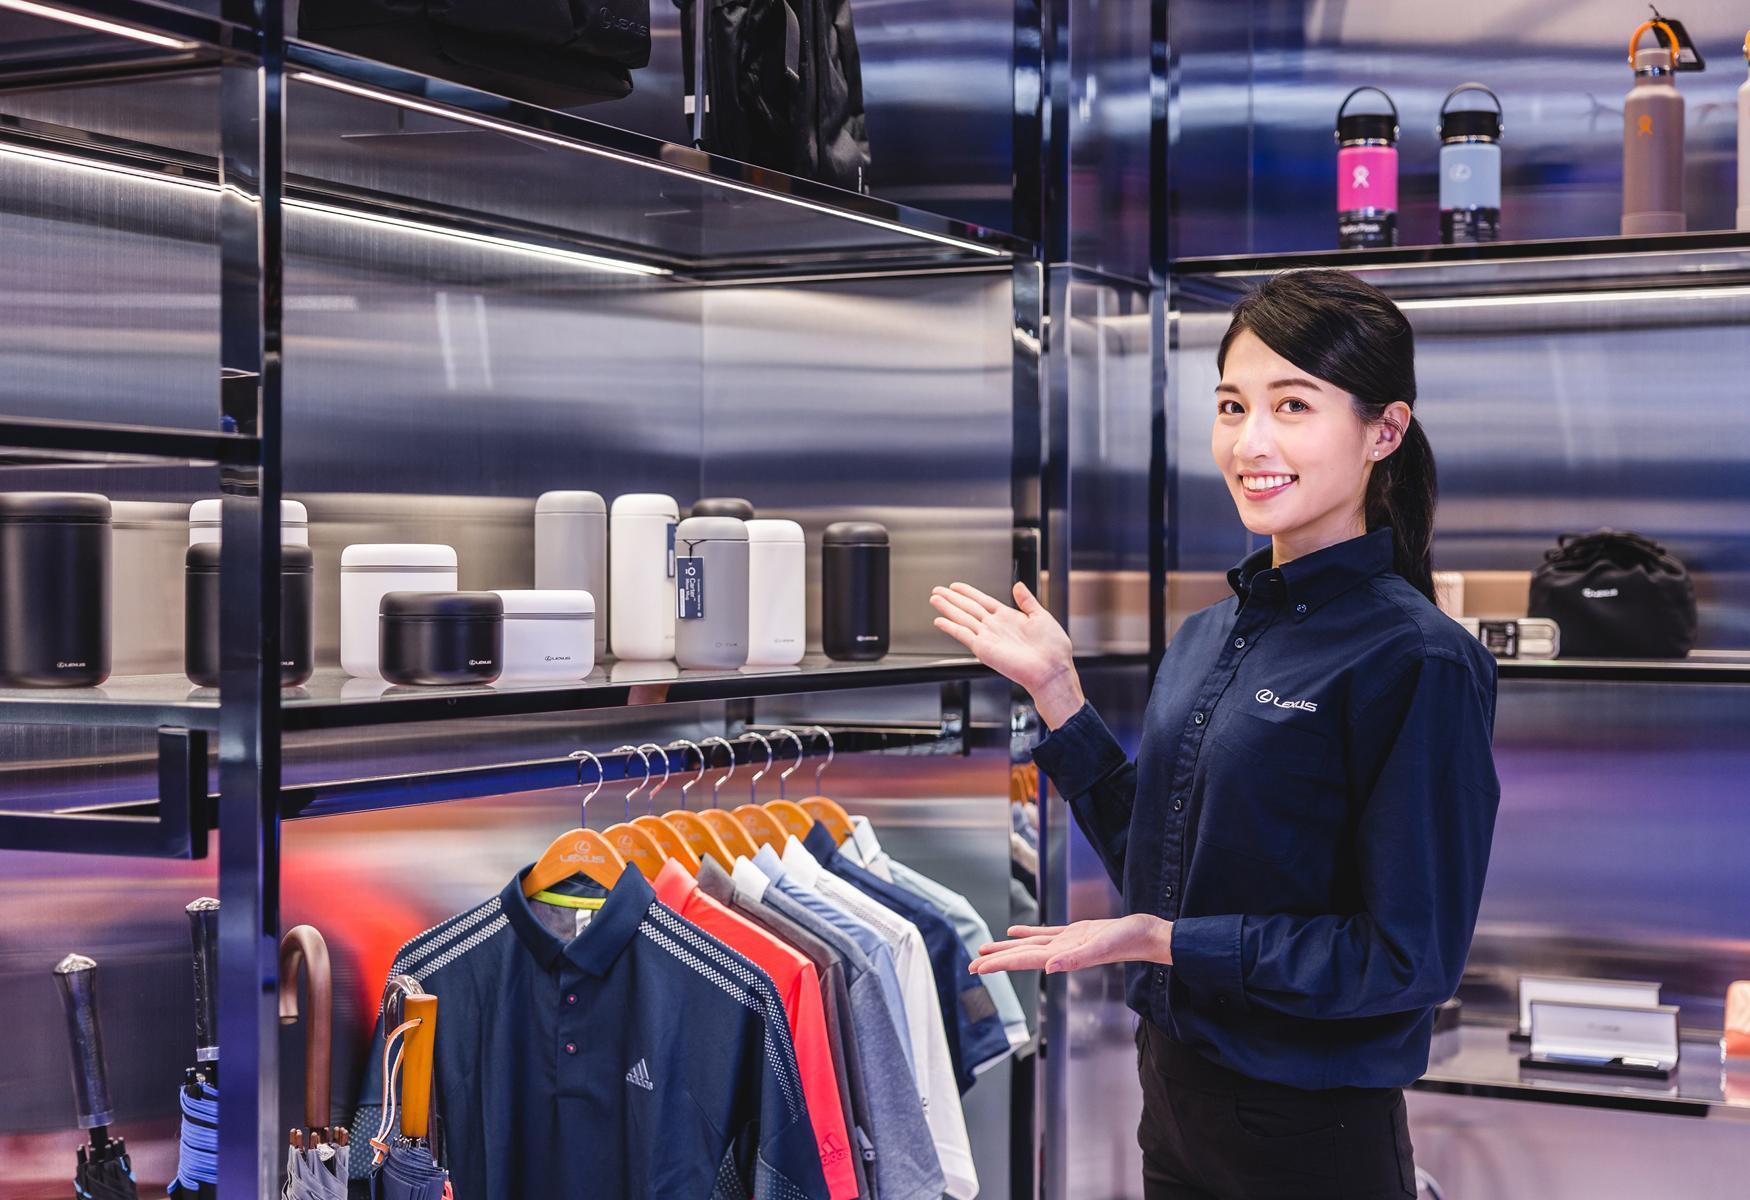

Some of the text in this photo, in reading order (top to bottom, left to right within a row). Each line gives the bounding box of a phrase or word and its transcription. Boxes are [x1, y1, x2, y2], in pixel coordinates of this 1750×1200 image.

[1273, 696, 1318, 712] LEXUS
[559, 853, 605, 864] LEXUS
[625, 1072, 654, 1091] adidas
